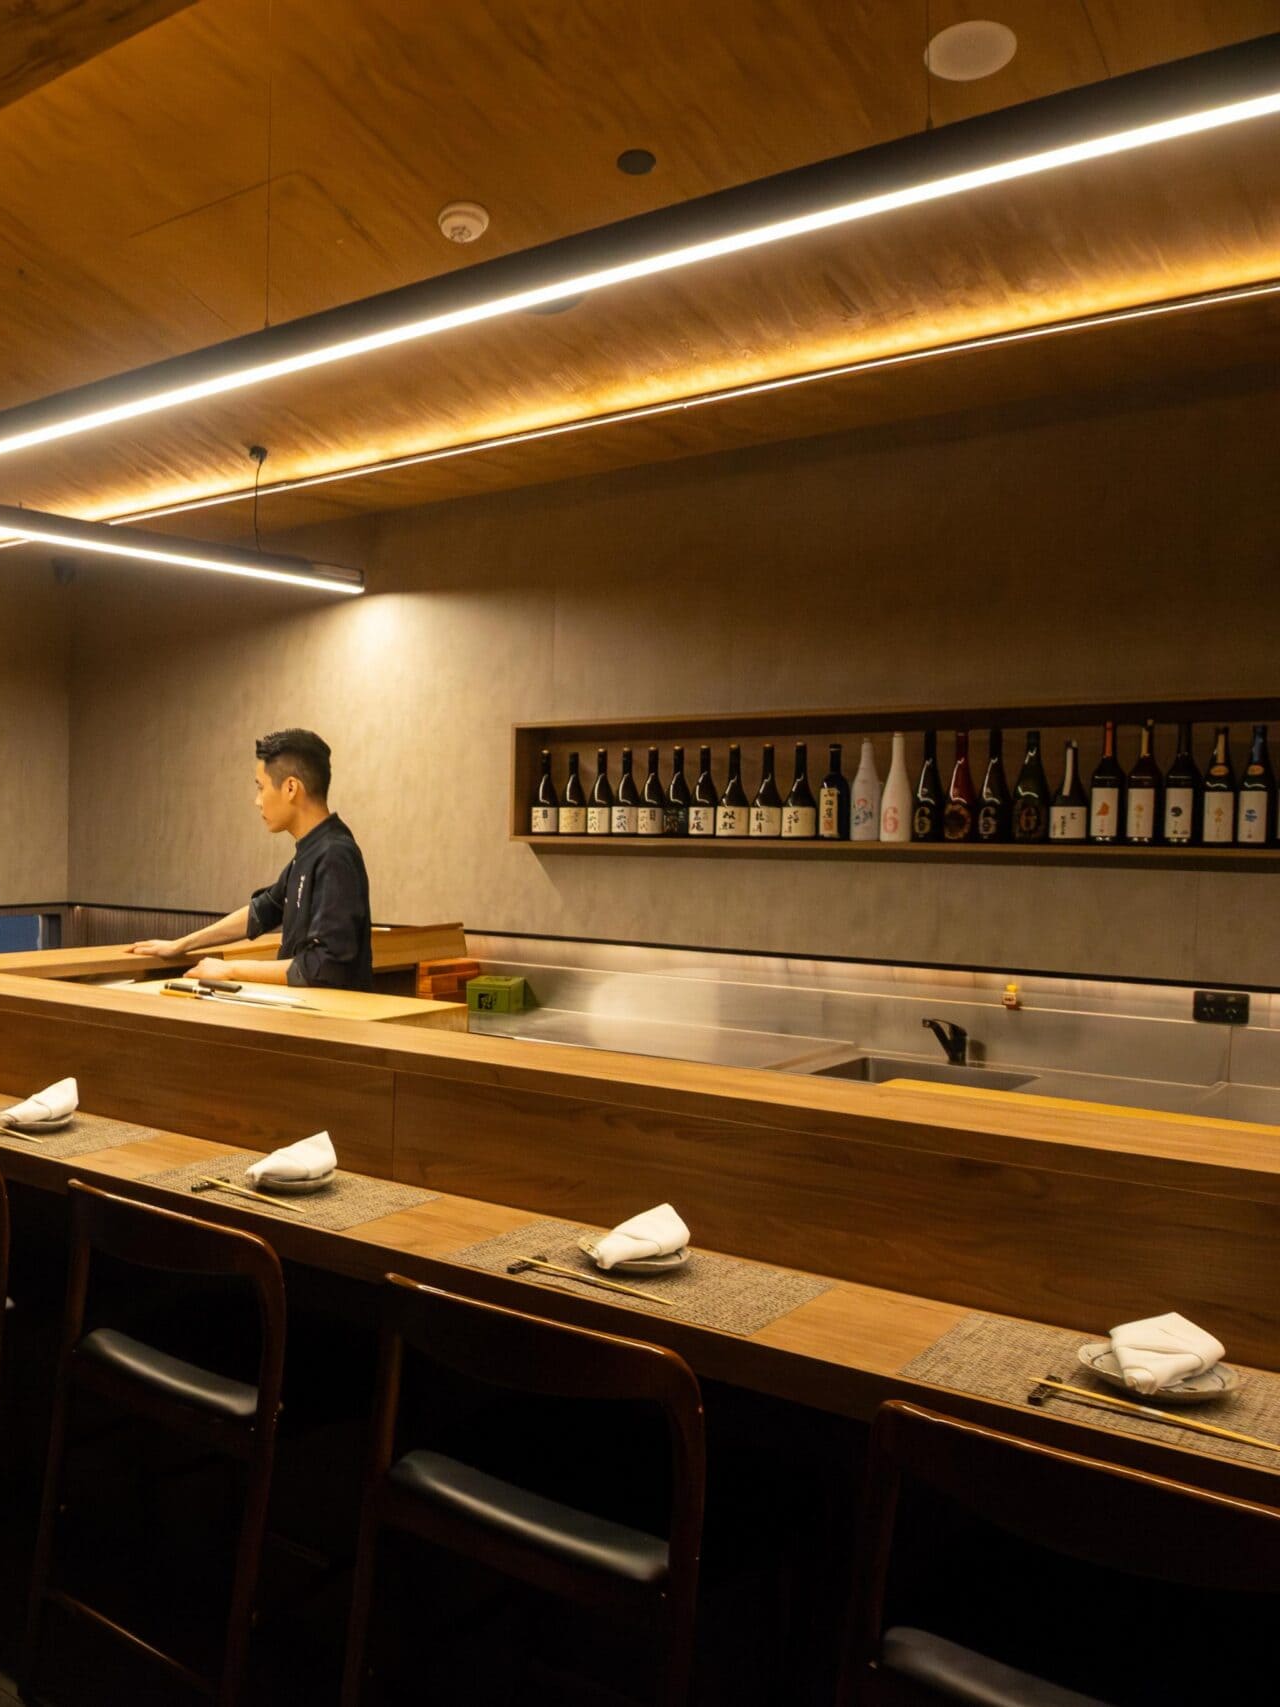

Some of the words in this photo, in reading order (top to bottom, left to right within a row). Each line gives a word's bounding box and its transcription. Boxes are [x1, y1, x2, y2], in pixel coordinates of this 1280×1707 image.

[884, 806, 898, 833] 6
[914, 806, 931, 834] 6
[979, 806, 996, 834] 6
